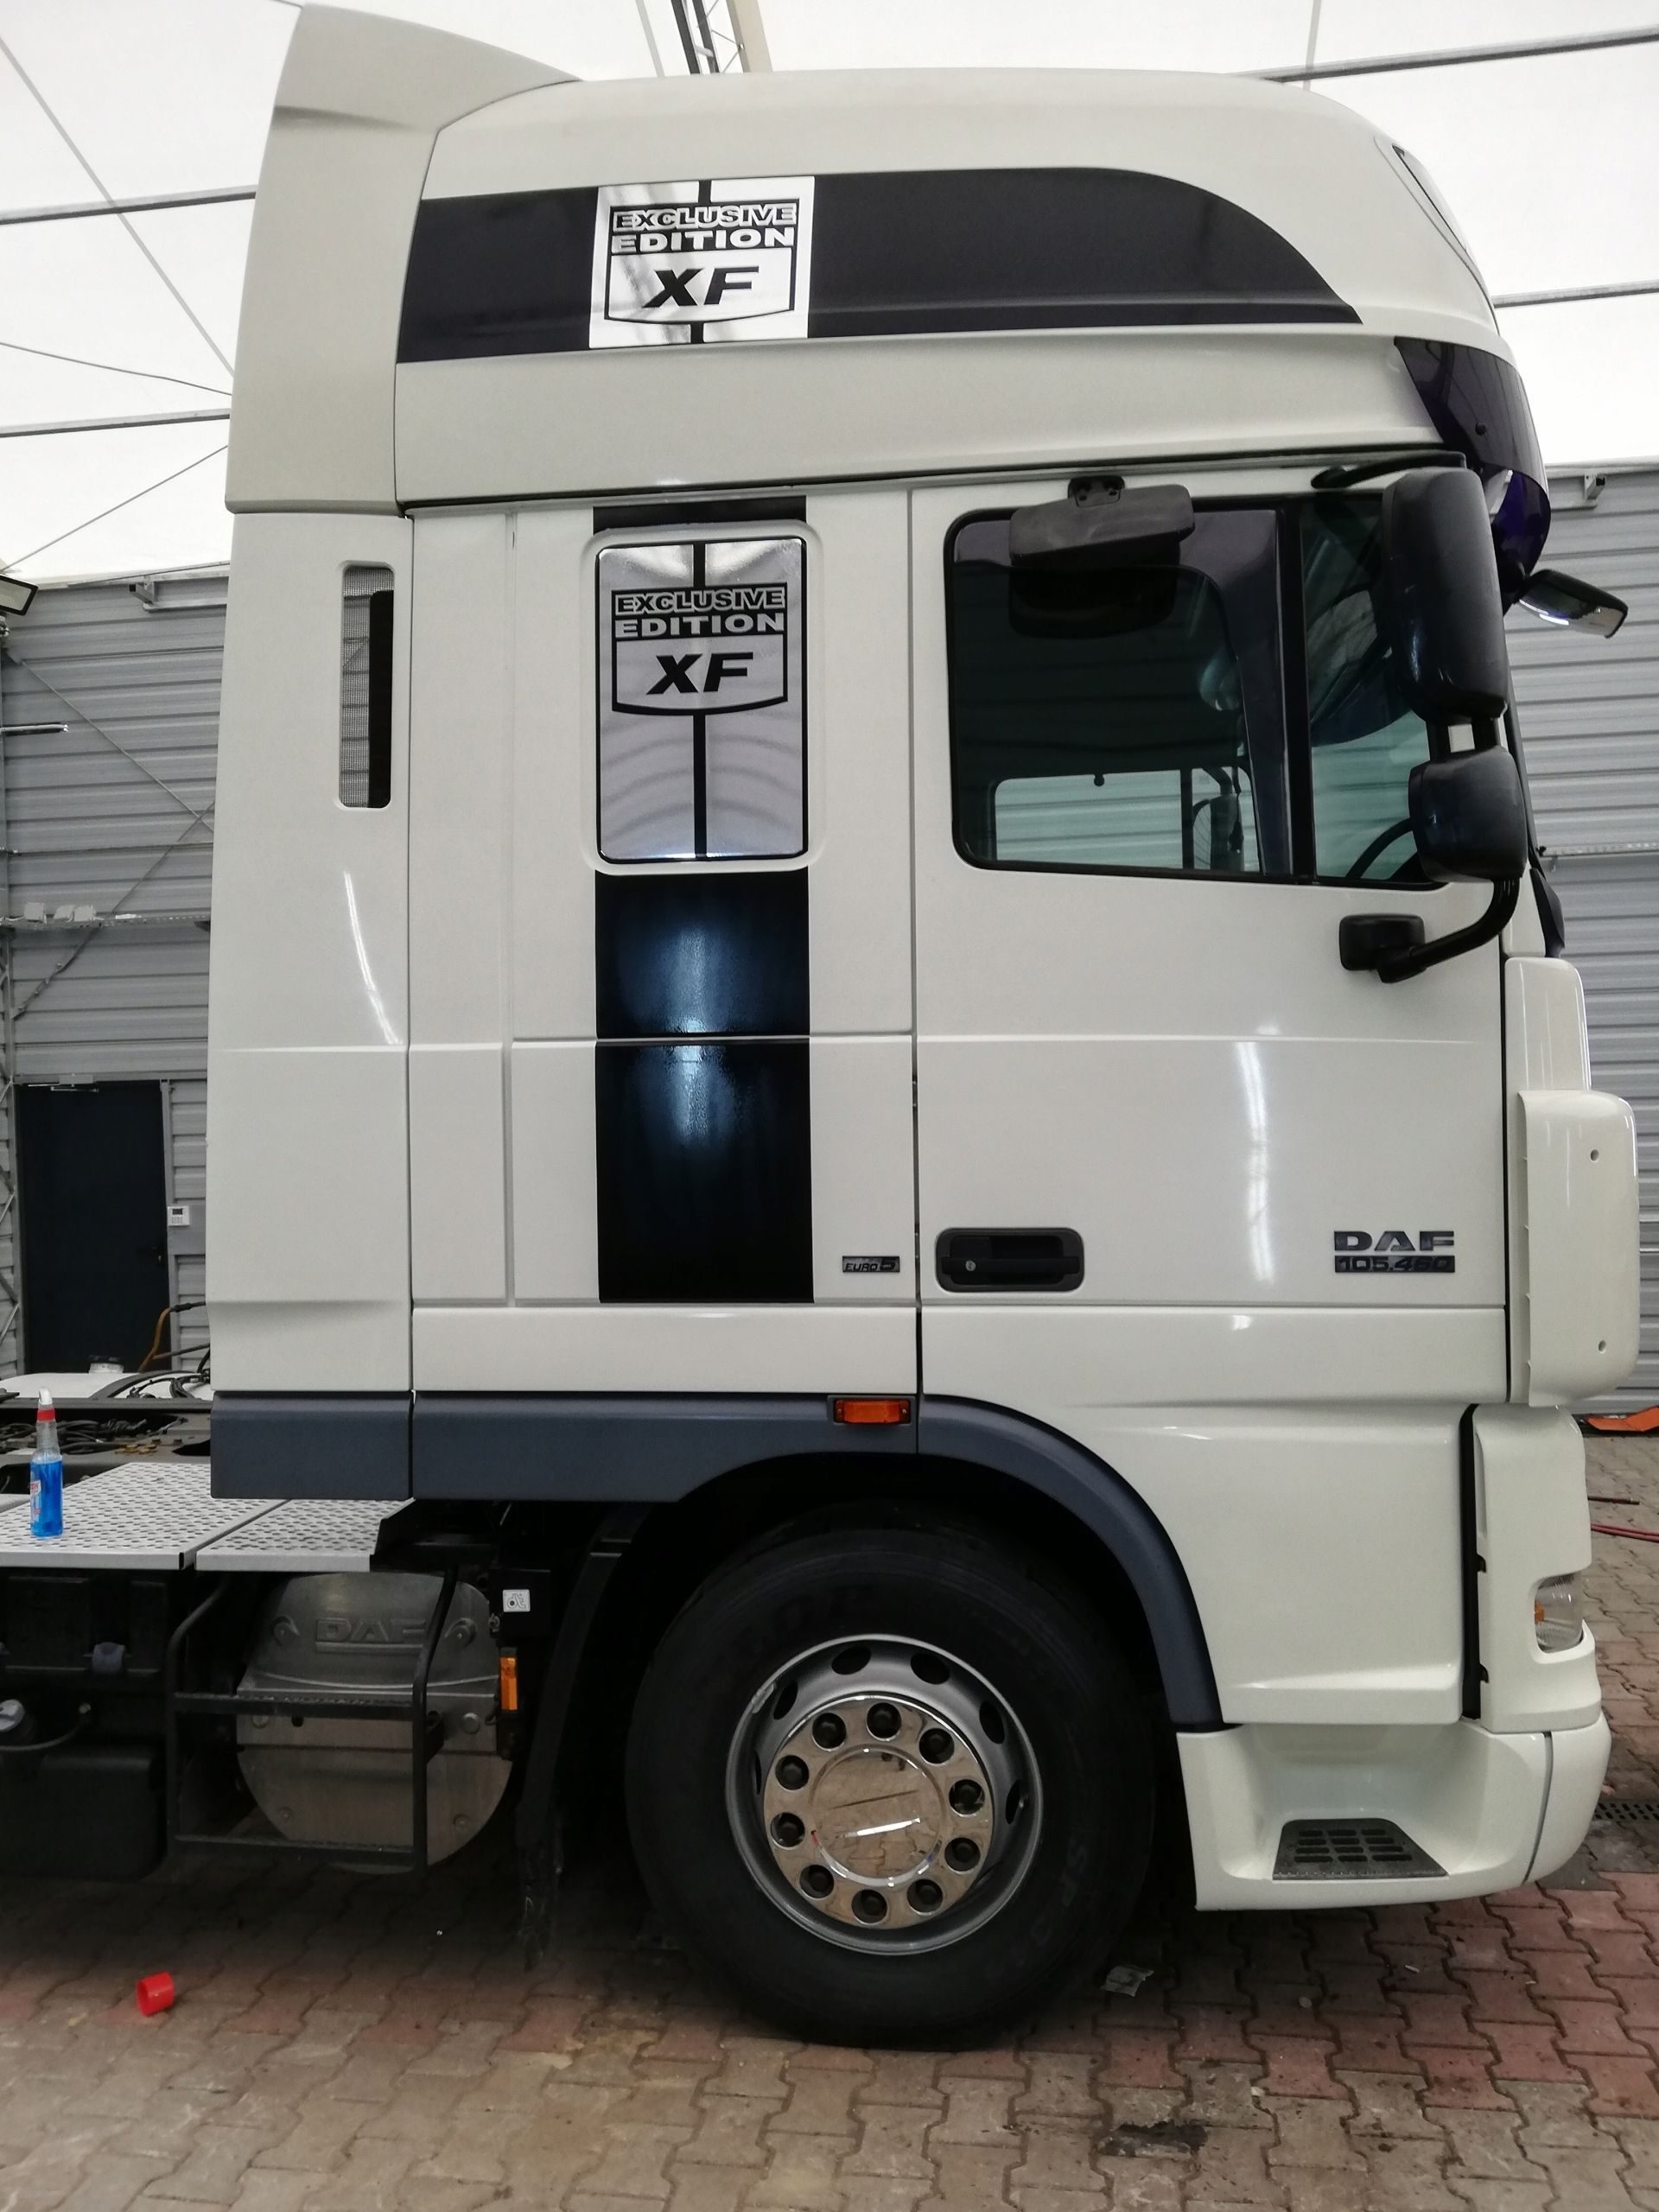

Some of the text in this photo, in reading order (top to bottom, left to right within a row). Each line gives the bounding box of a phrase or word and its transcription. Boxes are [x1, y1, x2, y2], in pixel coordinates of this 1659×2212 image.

[613, 202, 797, 232] EXCLUSIVE
[611, 227, 795, 254] EDITION
[641, 265, 760, 308] XF
[614, 587, 785, 616] EXCLUSIVE
[614, 612, 785, 639] EDITION
[645, 652, 753, 696] XF
[1334, 1230, 1454, 1251] DAF
[315, 1617, 427, 1642] DAF
